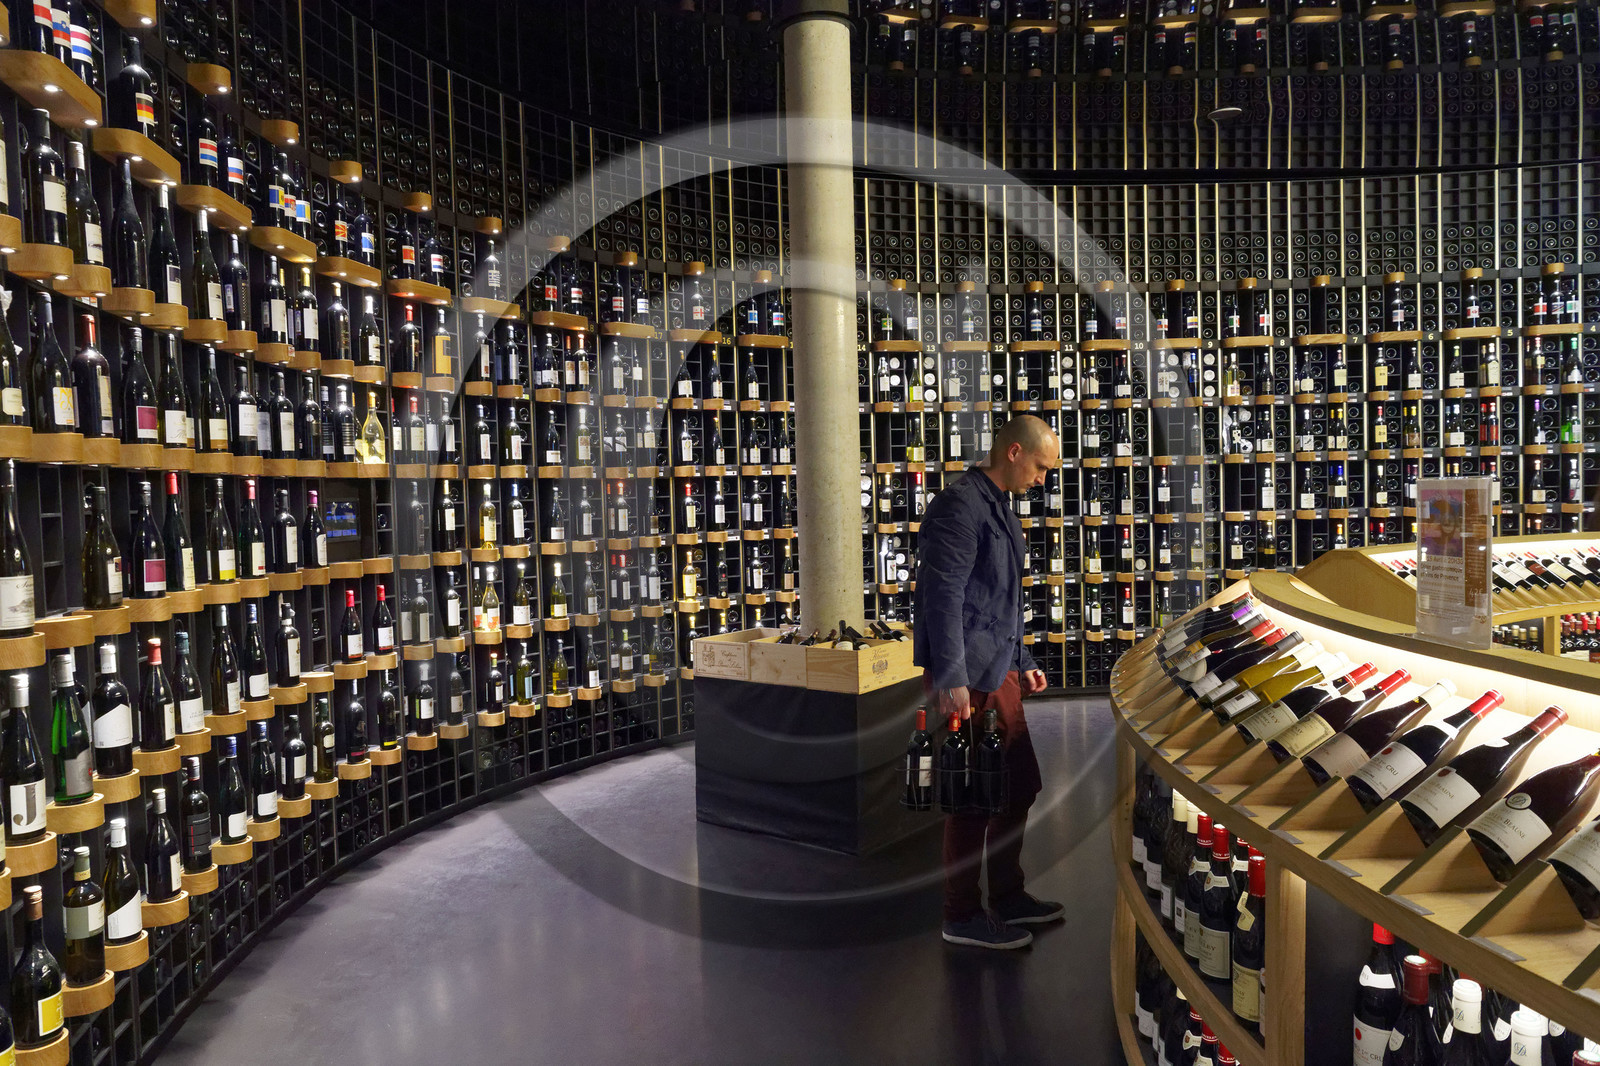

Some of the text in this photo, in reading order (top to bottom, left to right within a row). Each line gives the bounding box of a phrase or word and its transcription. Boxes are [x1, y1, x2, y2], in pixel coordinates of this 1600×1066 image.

[653, 331, 663, 340] 17
[1428, 332, 1434, 340] 6
[1507, 329, 1514, 337] 5
[722, 336, 732, 346] 16
[1279, 339, 1286, 347] 8
[1352, 336, 1359, 344] 7
[857, 344, 866, 352] 14
[926, 344, 936, 352] 13
[994, 344, 1004, 352] 12
[1064, 344, 1074, 352] 11
[1134, 342, 1144, 350] 10
[1207, 341, 1213, 349] 9
[1385, 764, 1399, 776] CRU
